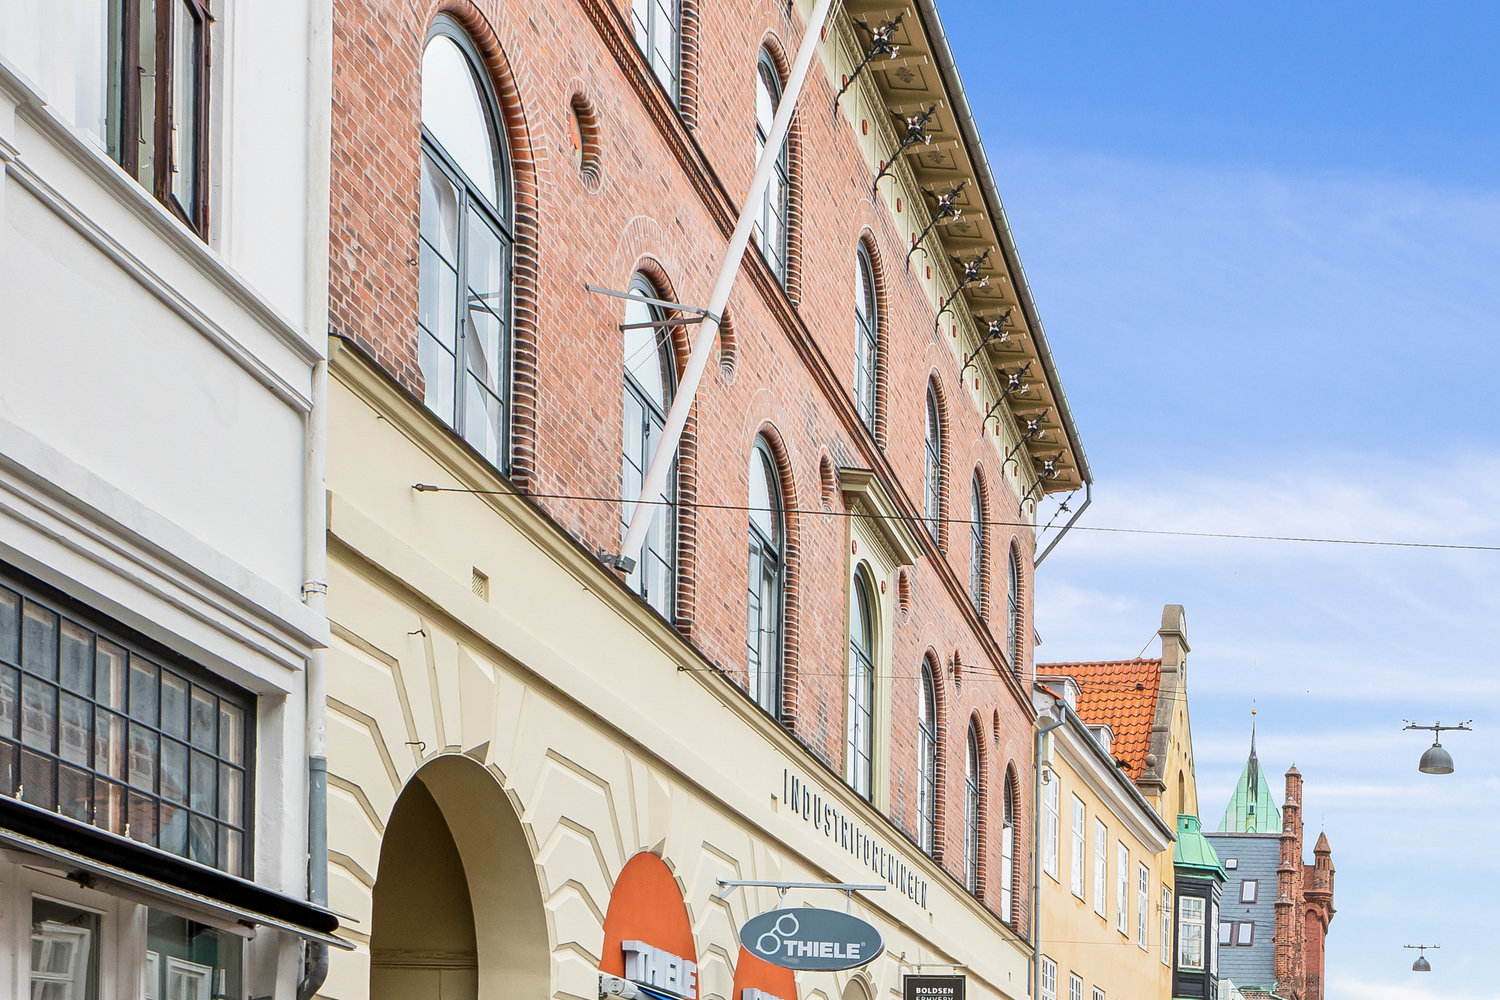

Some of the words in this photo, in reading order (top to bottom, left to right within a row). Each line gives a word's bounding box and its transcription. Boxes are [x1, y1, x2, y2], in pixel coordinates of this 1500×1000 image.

[784, 768, 928, 910] INDUSTRIFORENINGEN
[622, 940, 697, 1000] THIELE
[784, 940, 861, 960] THIELE
